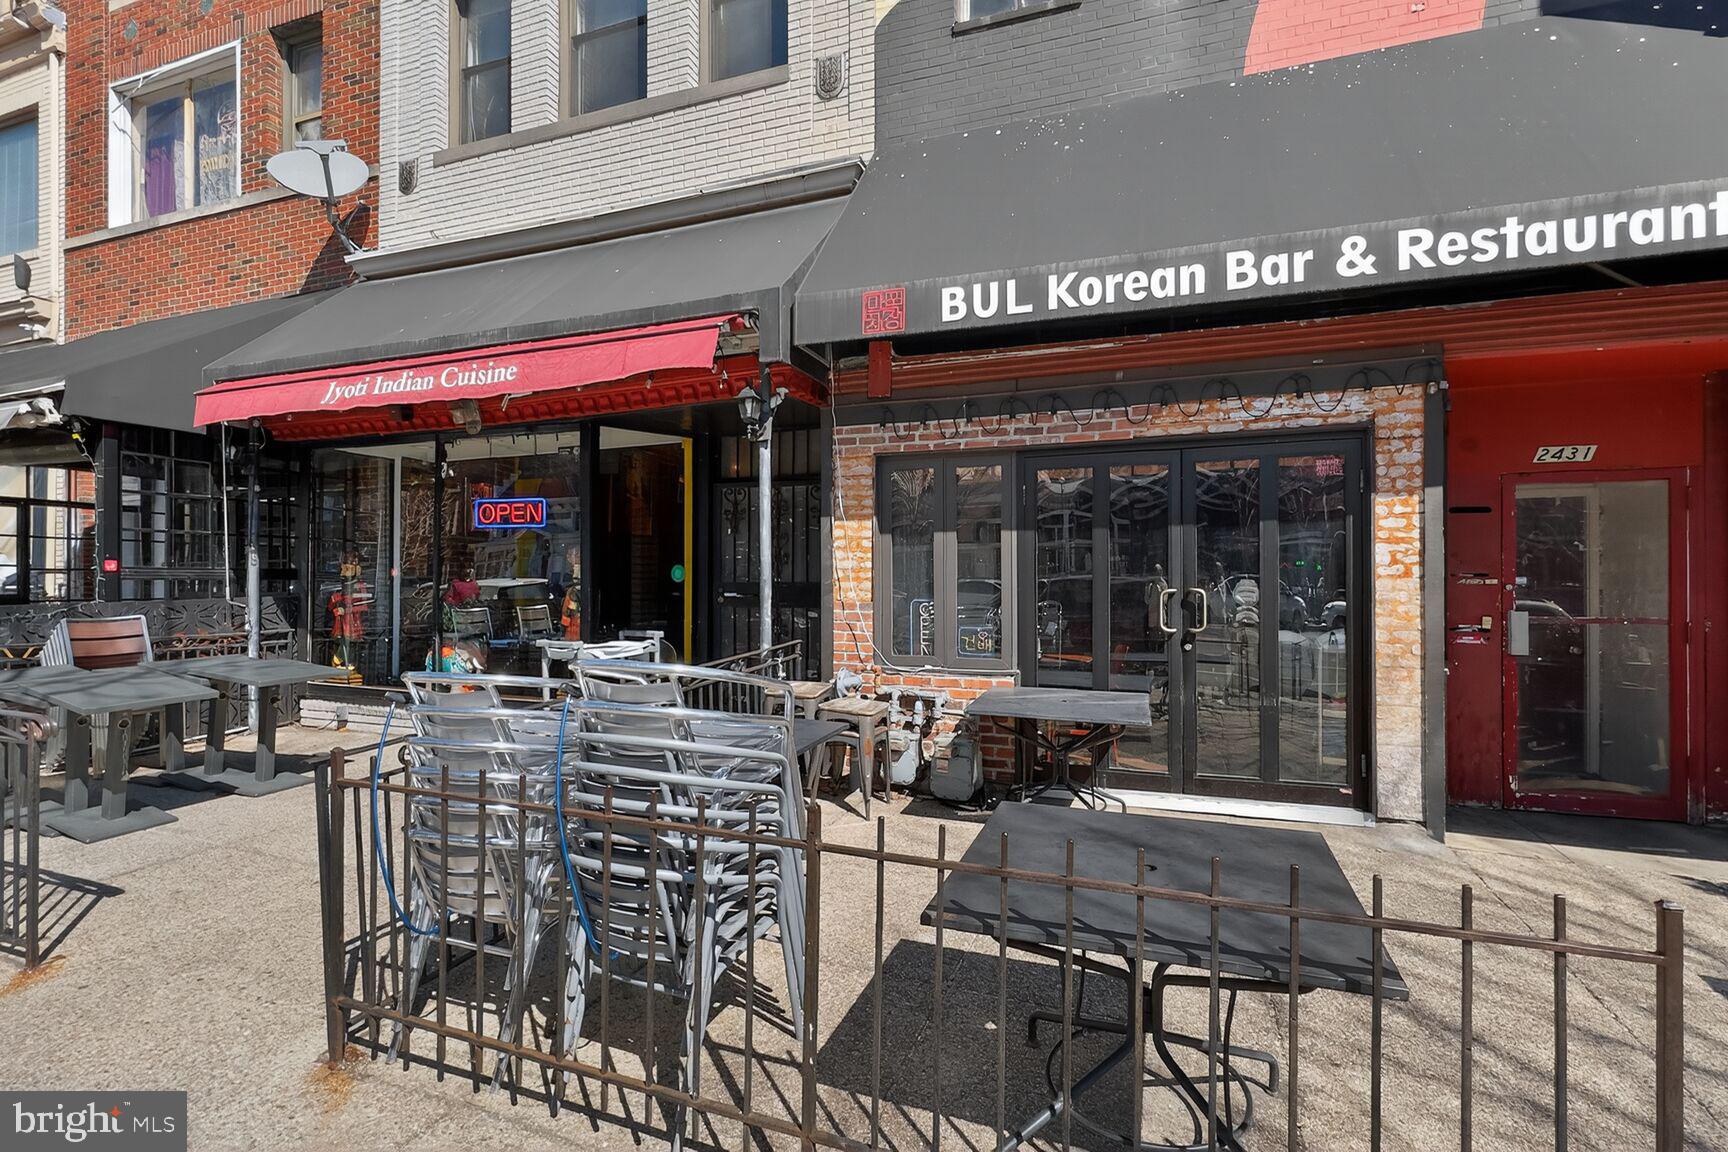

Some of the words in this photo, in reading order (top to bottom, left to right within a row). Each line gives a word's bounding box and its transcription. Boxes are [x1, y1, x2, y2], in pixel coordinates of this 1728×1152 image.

[941, 279, 1033, 322] BUL
[1047, 262, 1206, 310] Korean
[1226, 249, 1314, 290] Bar
[1335, 234, 1378, 278] &
[1398, 190, 1728, 271] Restaurant
[320, 377, 369, 405] Jyoti
[374, 371, 434, 395] Indian
[440, 361, 518, 388] Cuisine
[1536, 446, 1592, 461] 2431
[479, 502, 542, 523] OPEN
